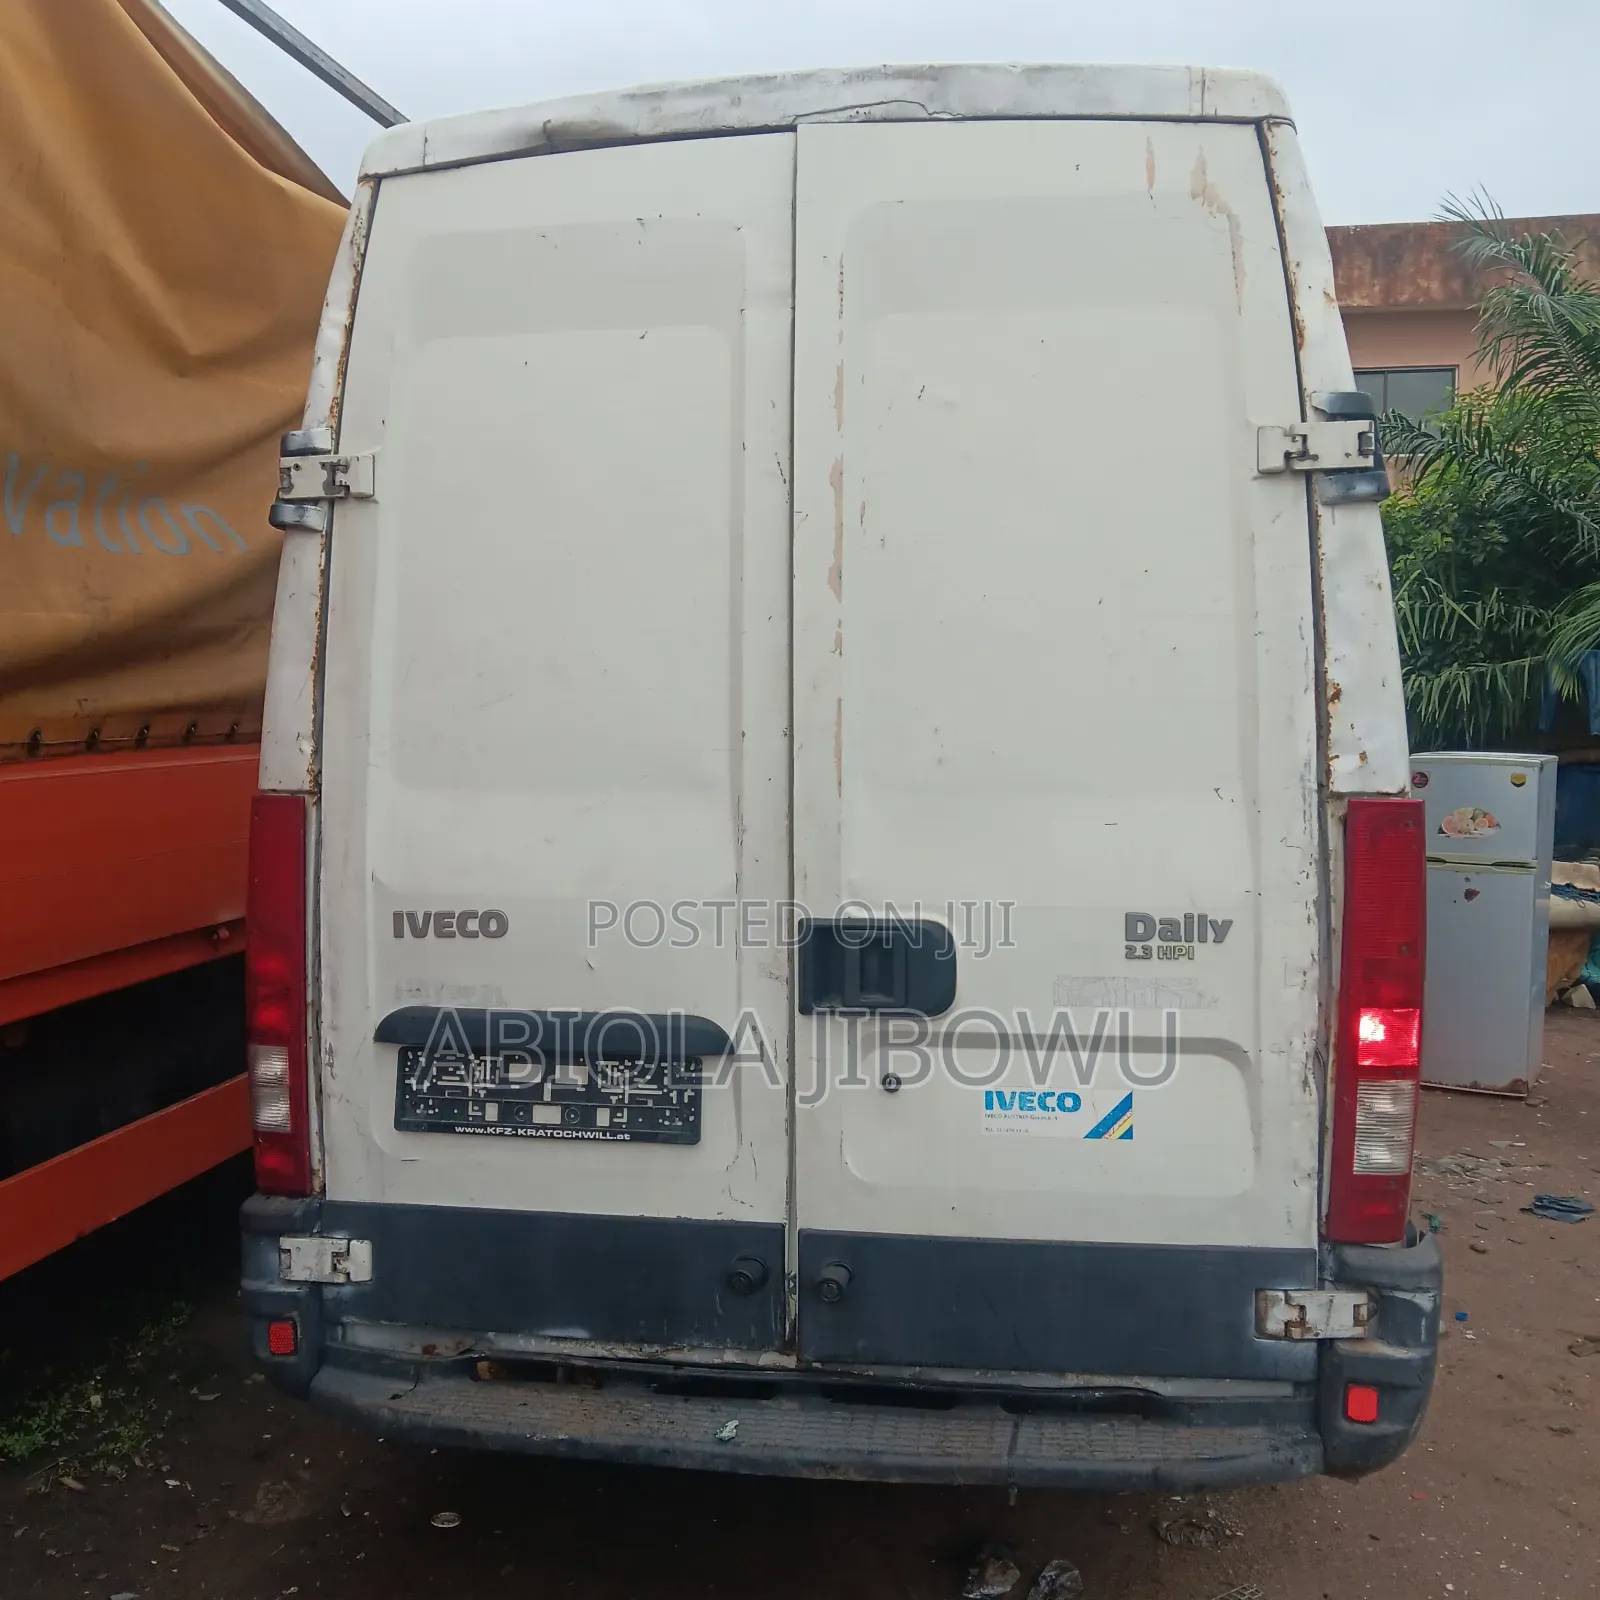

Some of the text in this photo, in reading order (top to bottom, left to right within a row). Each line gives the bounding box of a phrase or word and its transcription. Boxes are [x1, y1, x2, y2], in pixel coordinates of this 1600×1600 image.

[393, 910, 509, 938] IVECO
[1125, 912, 1234, 943] Daily
[1125, 945, 1195, 960] 2.3 HPI
[984, 1090, 1082, 1113] IVECO
[454, 1126, 631, 1141] www.KFZ-KRATOCHWILL.at
